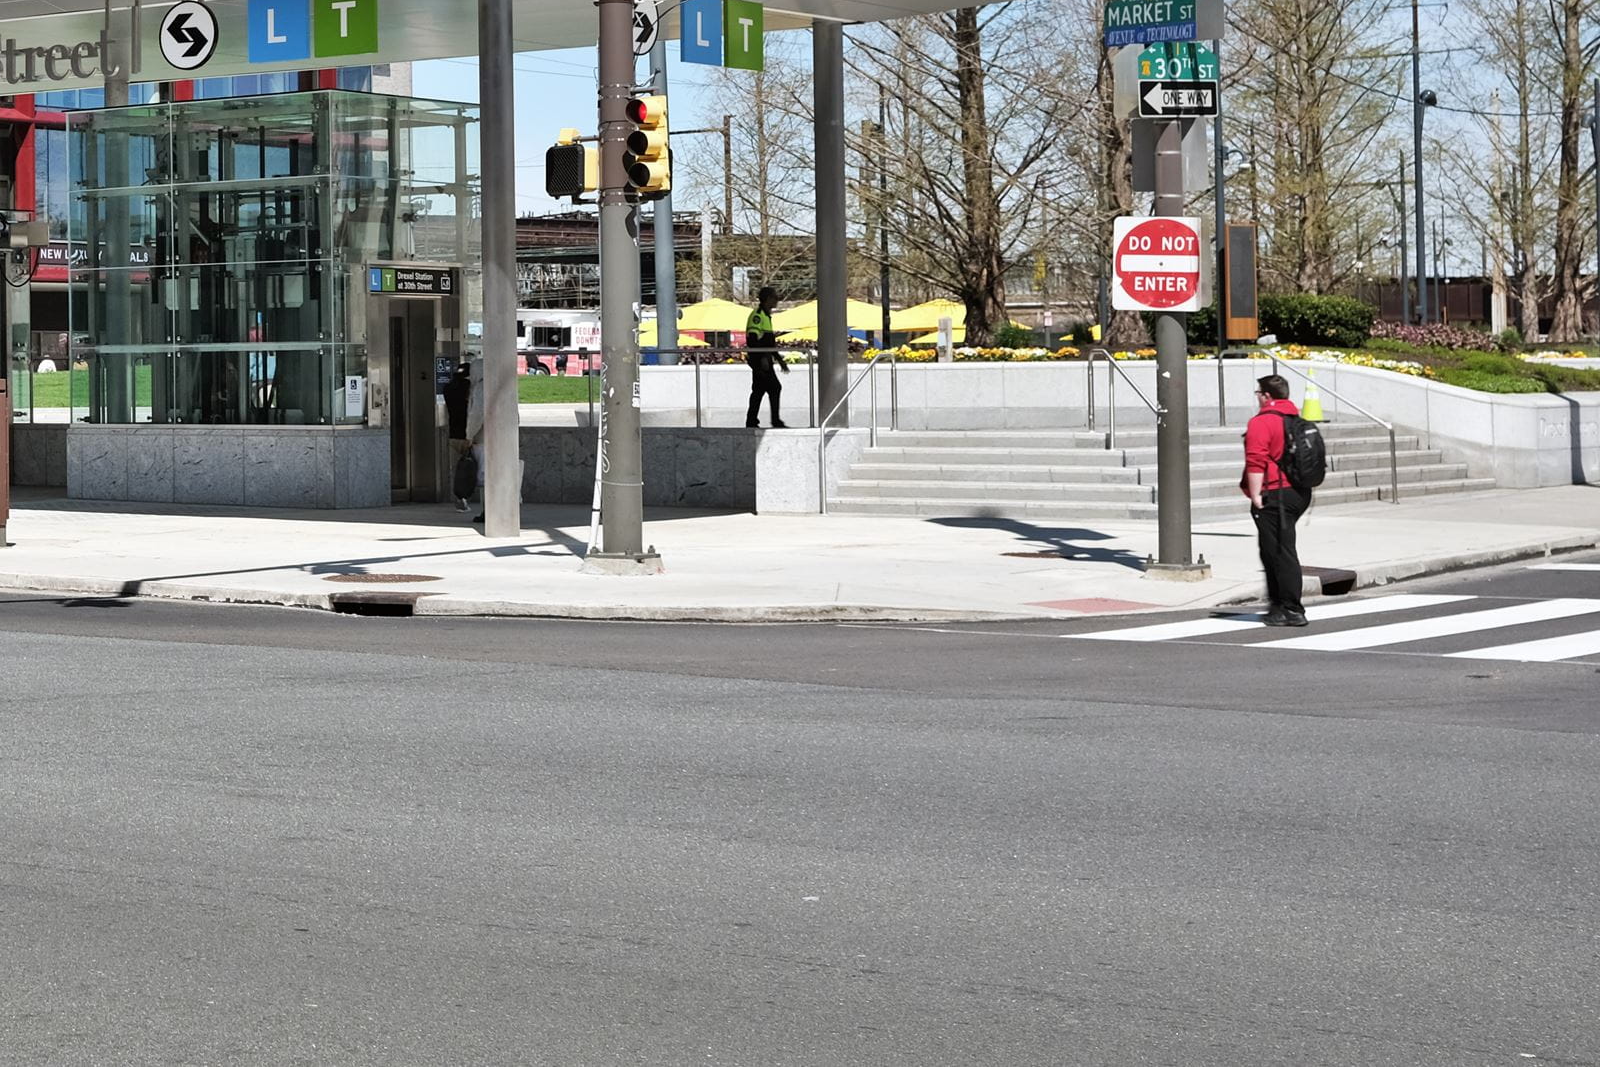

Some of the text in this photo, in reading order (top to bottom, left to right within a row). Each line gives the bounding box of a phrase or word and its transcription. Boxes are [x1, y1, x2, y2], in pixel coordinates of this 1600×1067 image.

[267, 0, 357, 44] L T
[1108, 1, 1193, 27] MARKET ST
[696, 11, 753, 53] L T
[1107, 29, 1136, 45] AVENUE
[1146, 23, 1194, 42] TECHNOLOGY
[1155, 57, 1214, 79] 30TH ST
[1162, 91, 1209, 105] ONE WAY
[1129, 235, 1195, 251] DO NOT
[40, 248, 62, 260] NEW
[372, 274, 392, 286] L T
[397, 271, 434, 281] Drexel Station
[1134, 276, 1188, 292] ENTER
[397, 281, 433, 291] at 30th Street
[575, 326, 600, 336] FEDERA
